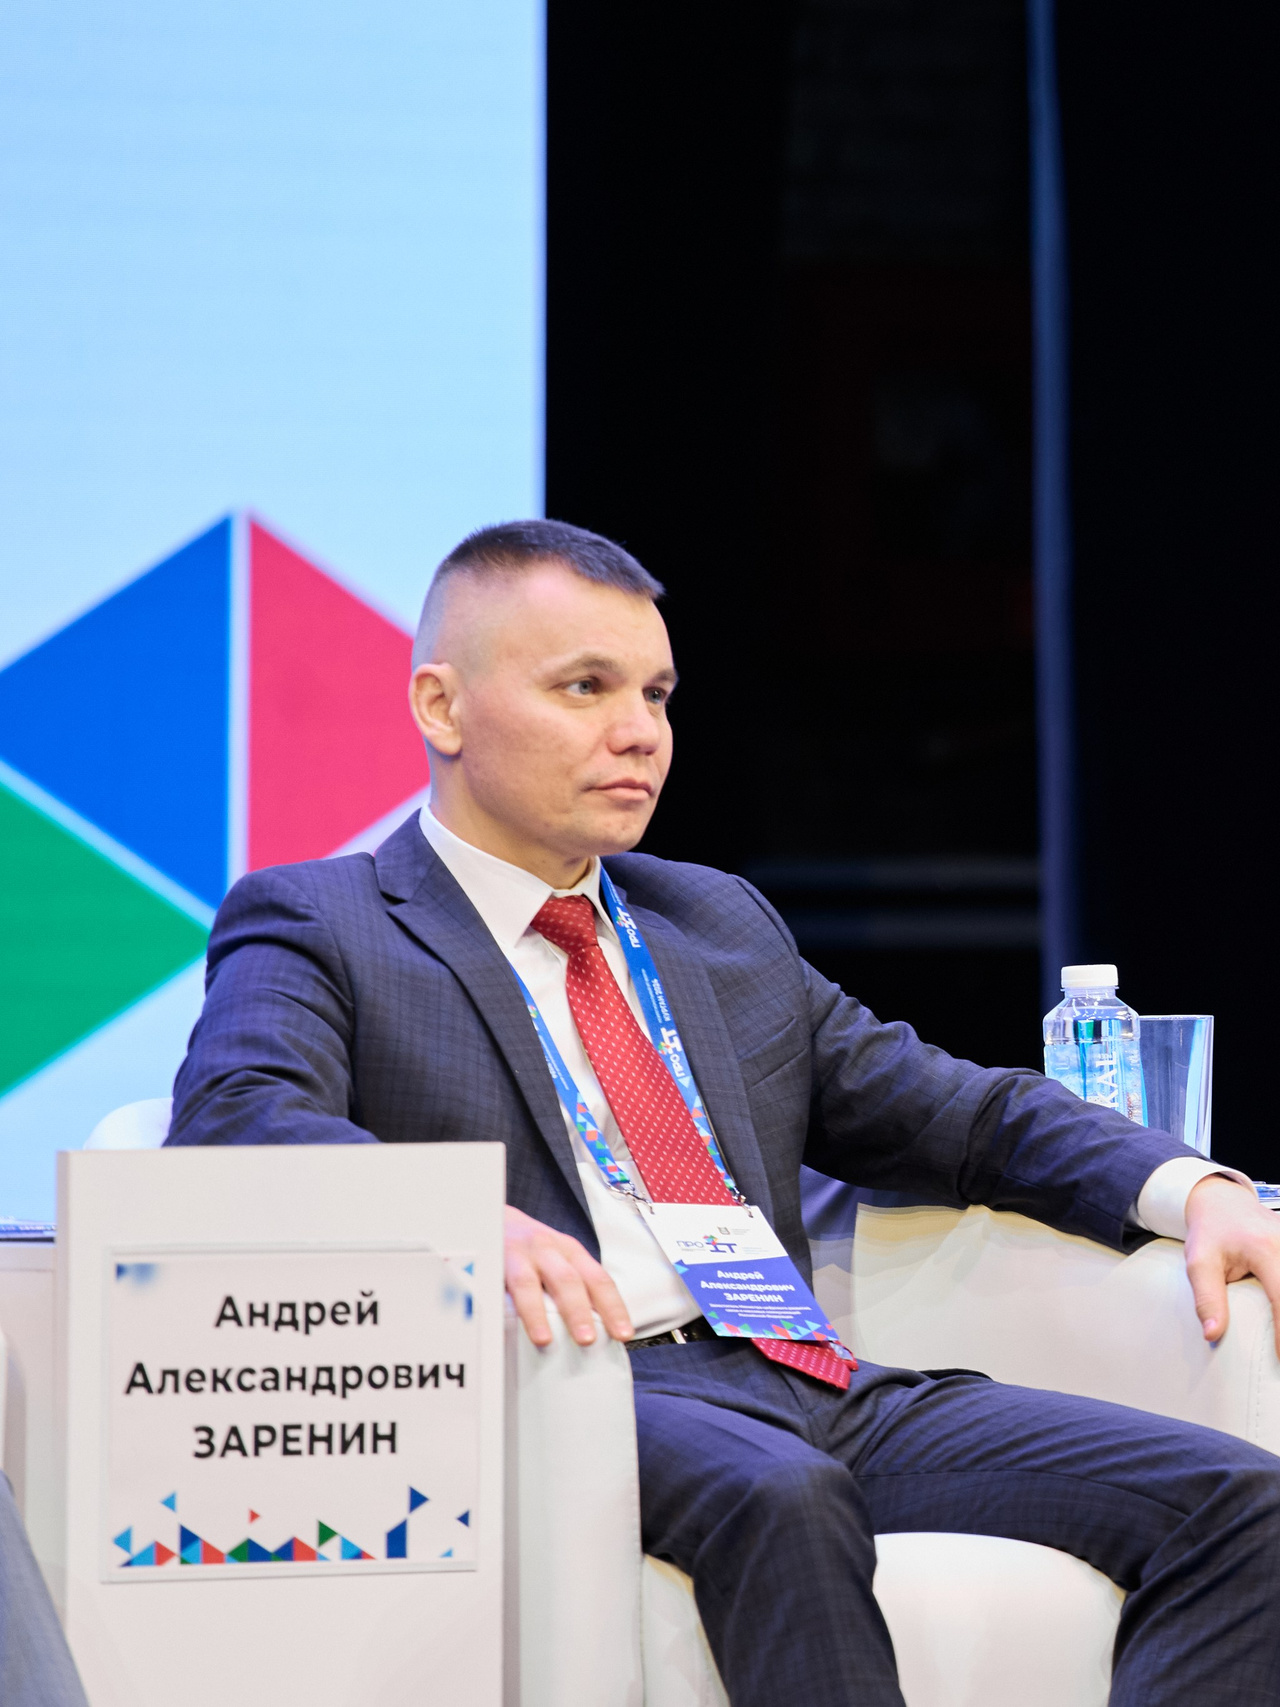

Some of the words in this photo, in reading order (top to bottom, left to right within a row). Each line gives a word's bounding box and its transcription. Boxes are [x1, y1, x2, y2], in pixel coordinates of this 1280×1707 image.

[1096, 1051, 1119, 1108] KAL
[700, 1280, 795, 1292] Александрович
[717, 1270, 764, 1281] Андрей
[214, 1290, 381, 1335] Андрей
[723, 1292, 784, 1303] ЗАРЕНИН
[124, 1361, 466, 1398] Александрович
[192, 1420, 398, 1459] ЗАРЕНИН
